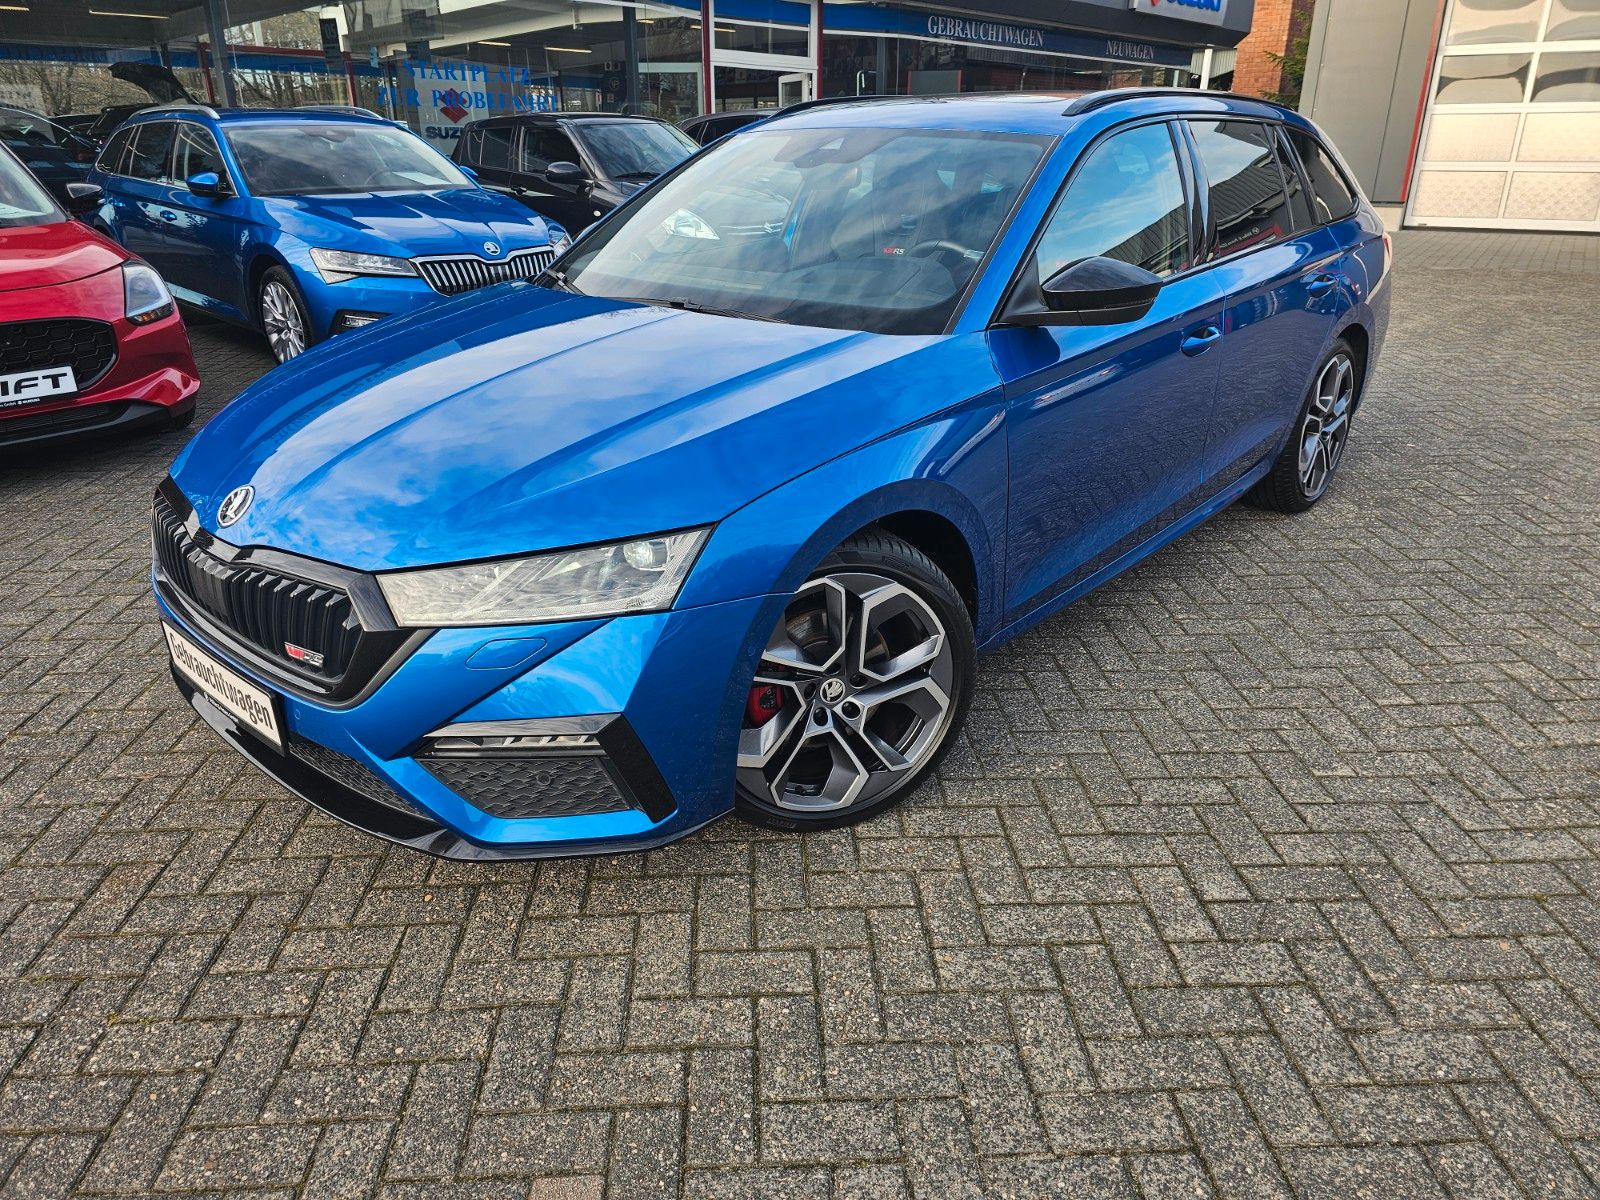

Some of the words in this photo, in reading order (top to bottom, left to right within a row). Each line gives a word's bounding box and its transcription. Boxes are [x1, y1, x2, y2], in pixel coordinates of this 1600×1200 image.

[927, 15, 1044, 47] GEBRAUCHTWAGEN
[1105, 39, 1155, 60] NEUWAGEN
[425, 126, 464, 140] SUZ
[169, 632, 274, 730] Gebrauchtwagen
